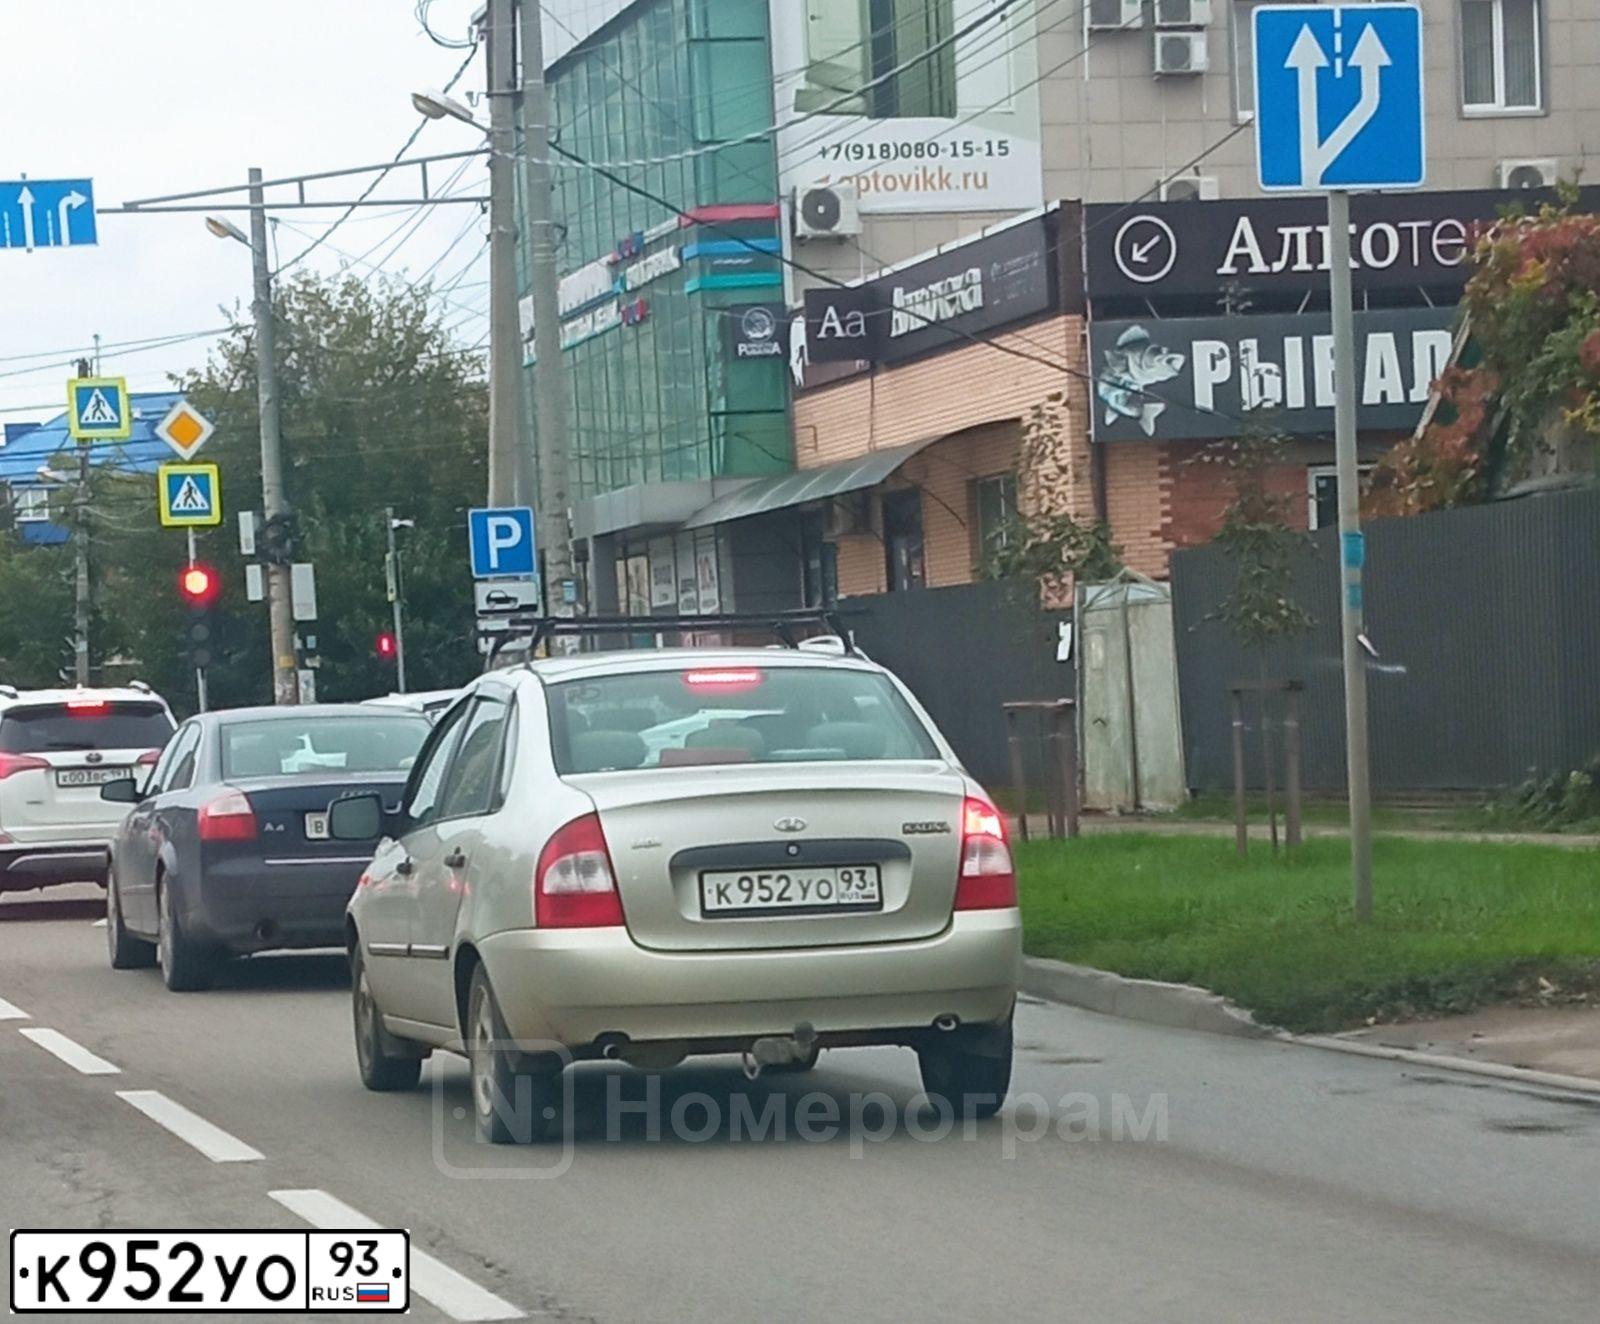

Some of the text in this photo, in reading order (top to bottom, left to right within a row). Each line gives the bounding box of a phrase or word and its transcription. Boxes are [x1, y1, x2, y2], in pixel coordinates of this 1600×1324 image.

[818, 139, 1010, 161] +7(918)080-15-15
[715, 869, 868, 905] К952УО 93
